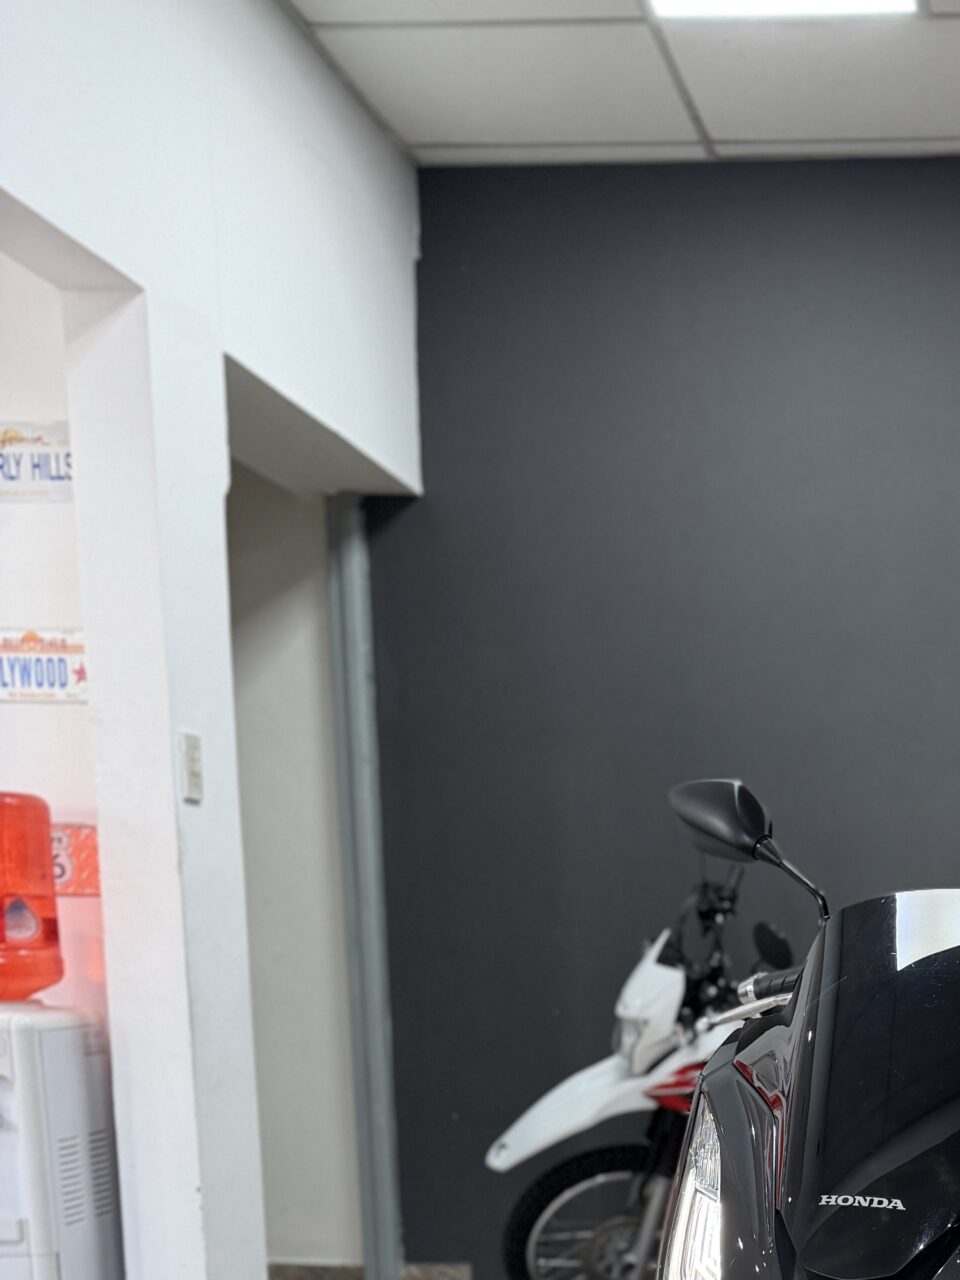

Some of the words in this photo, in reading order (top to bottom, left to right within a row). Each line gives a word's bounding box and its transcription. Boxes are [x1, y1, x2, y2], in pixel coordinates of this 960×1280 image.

[30, 451, 72, 481] HILLS
[0, 656, 68, 689] LYWOOD
[819, 1195, 906, 1211] HONDA
